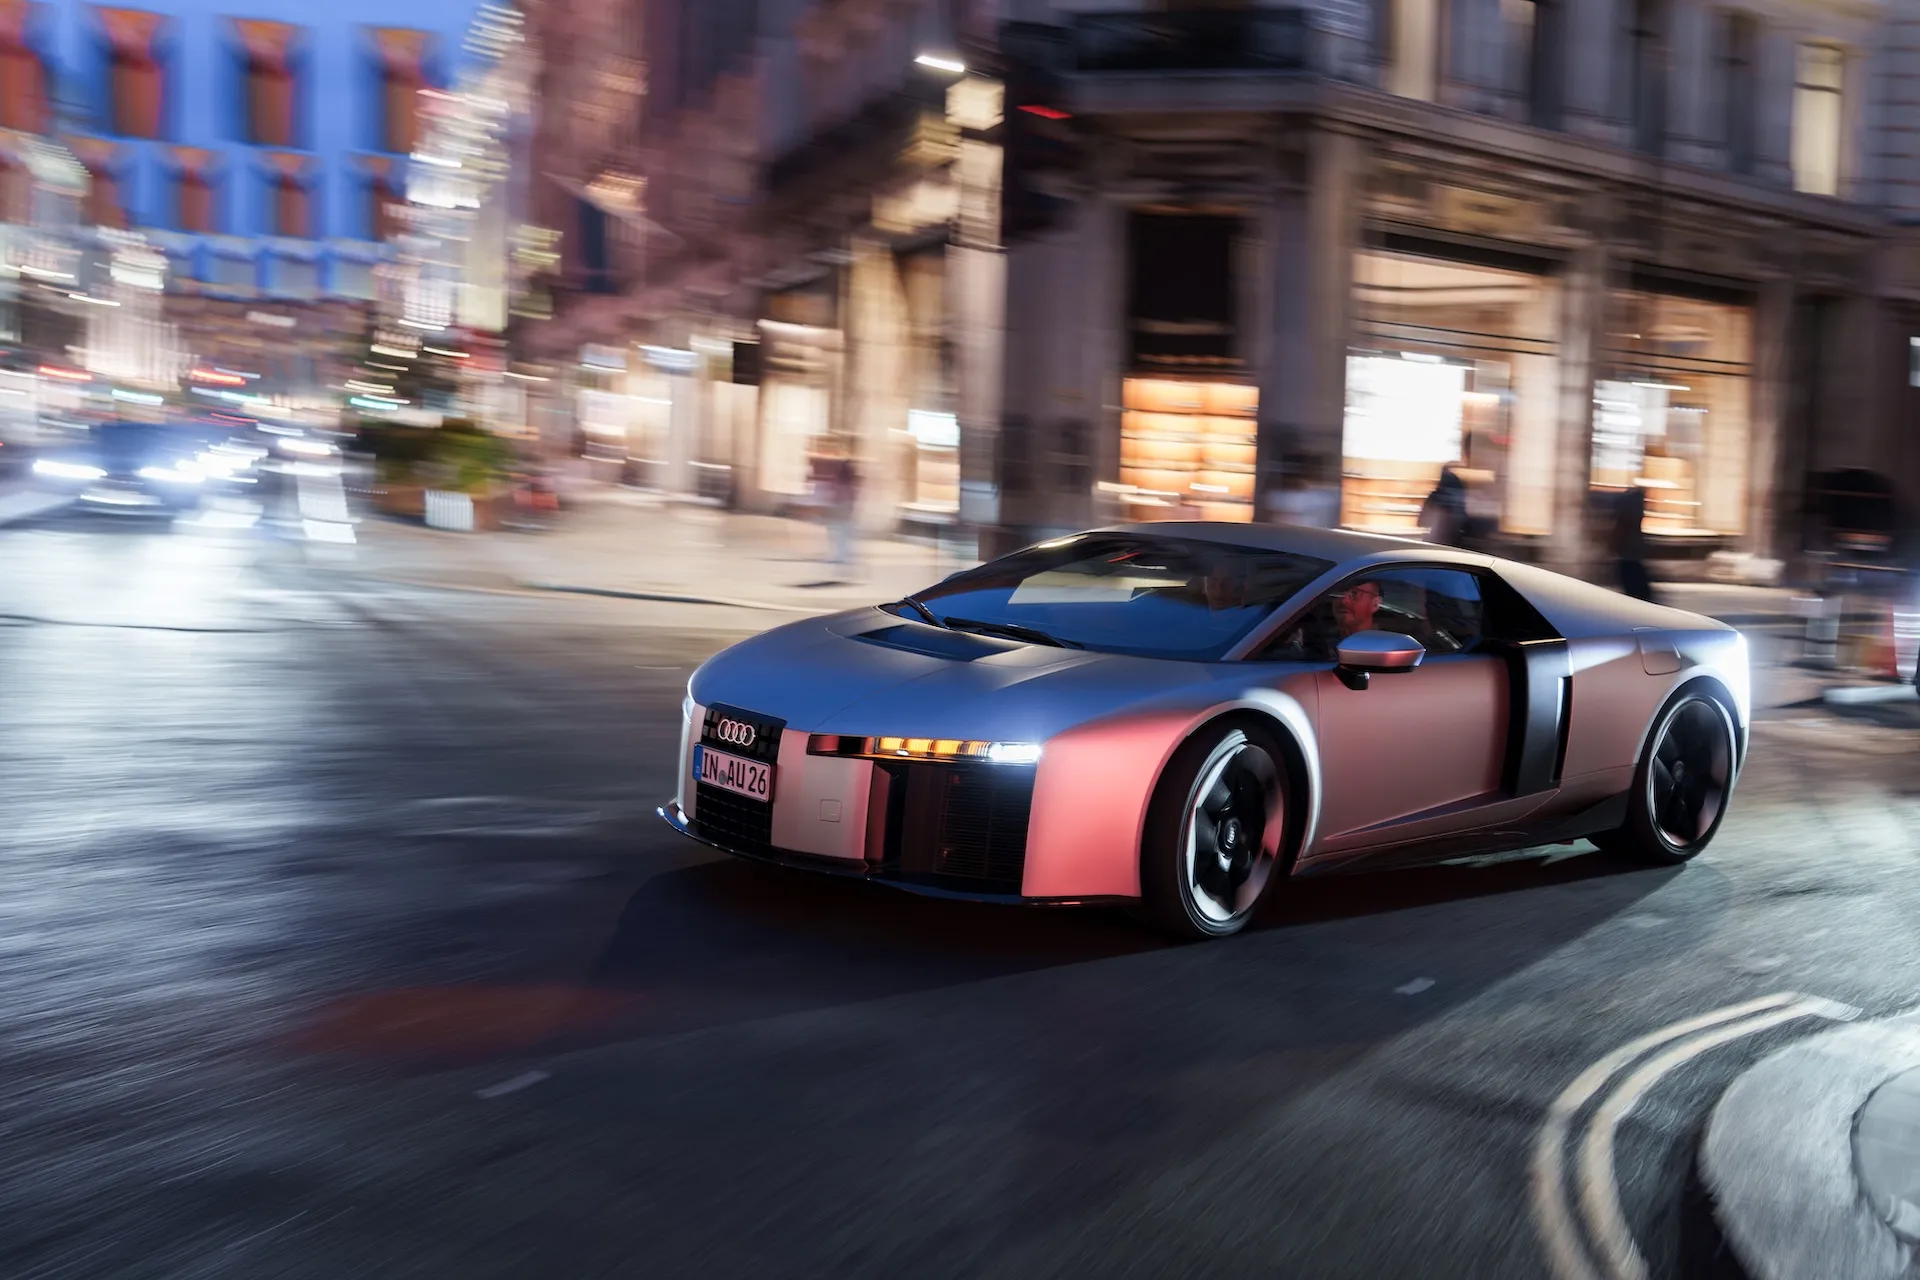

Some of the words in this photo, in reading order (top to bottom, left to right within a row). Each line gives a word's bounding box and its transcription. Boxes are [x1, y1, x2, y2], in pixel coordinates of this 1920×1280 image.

[702, 752, 719, 781] IN
[726, 760, 746, 790] AU
[748, 766, 766, 795] 26
